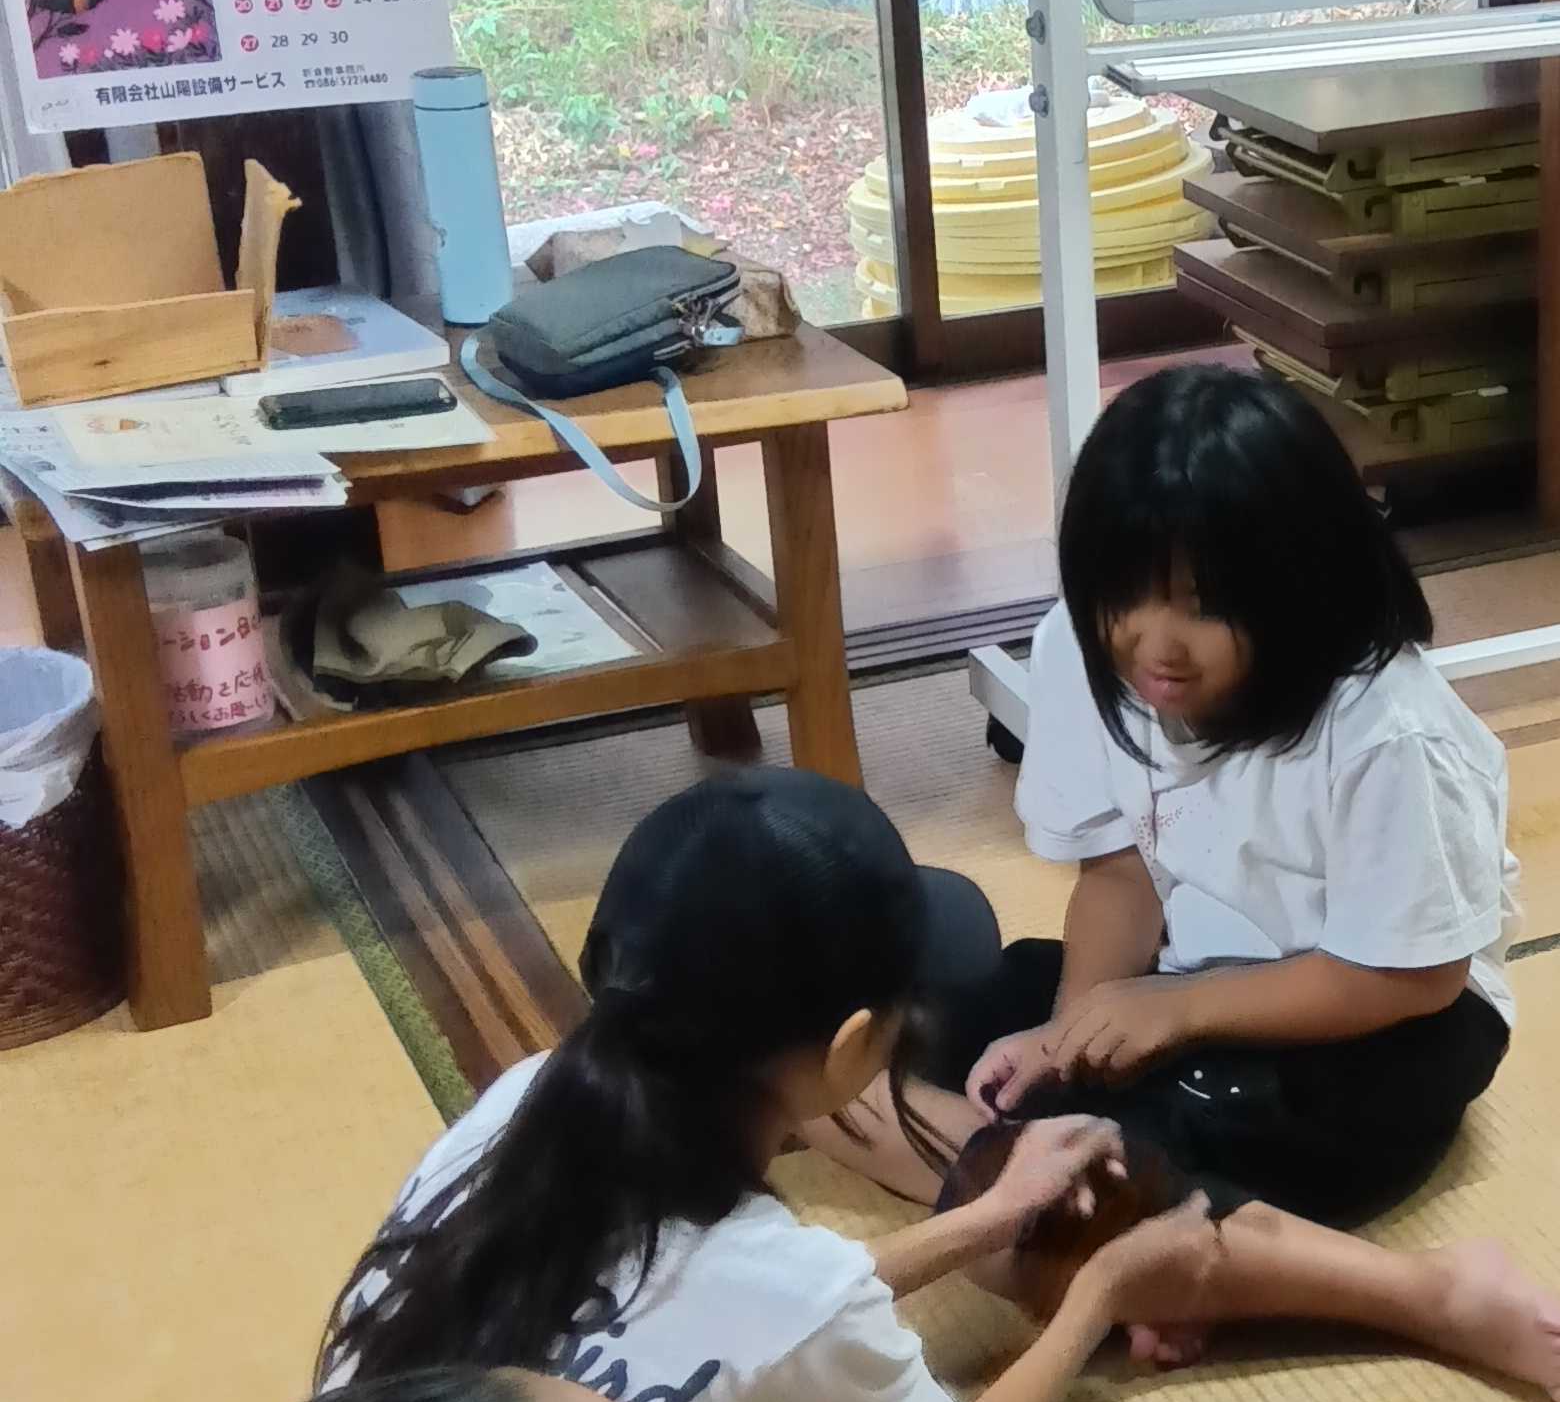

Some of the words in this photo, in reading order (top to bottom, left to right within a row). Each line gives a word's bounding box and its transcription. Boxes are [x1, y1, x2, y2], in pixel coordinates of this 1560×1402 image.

[271, 34, 288, 47] 28
[301, 33, 318, 46] 29
[330, 31, 348, 44] 30
